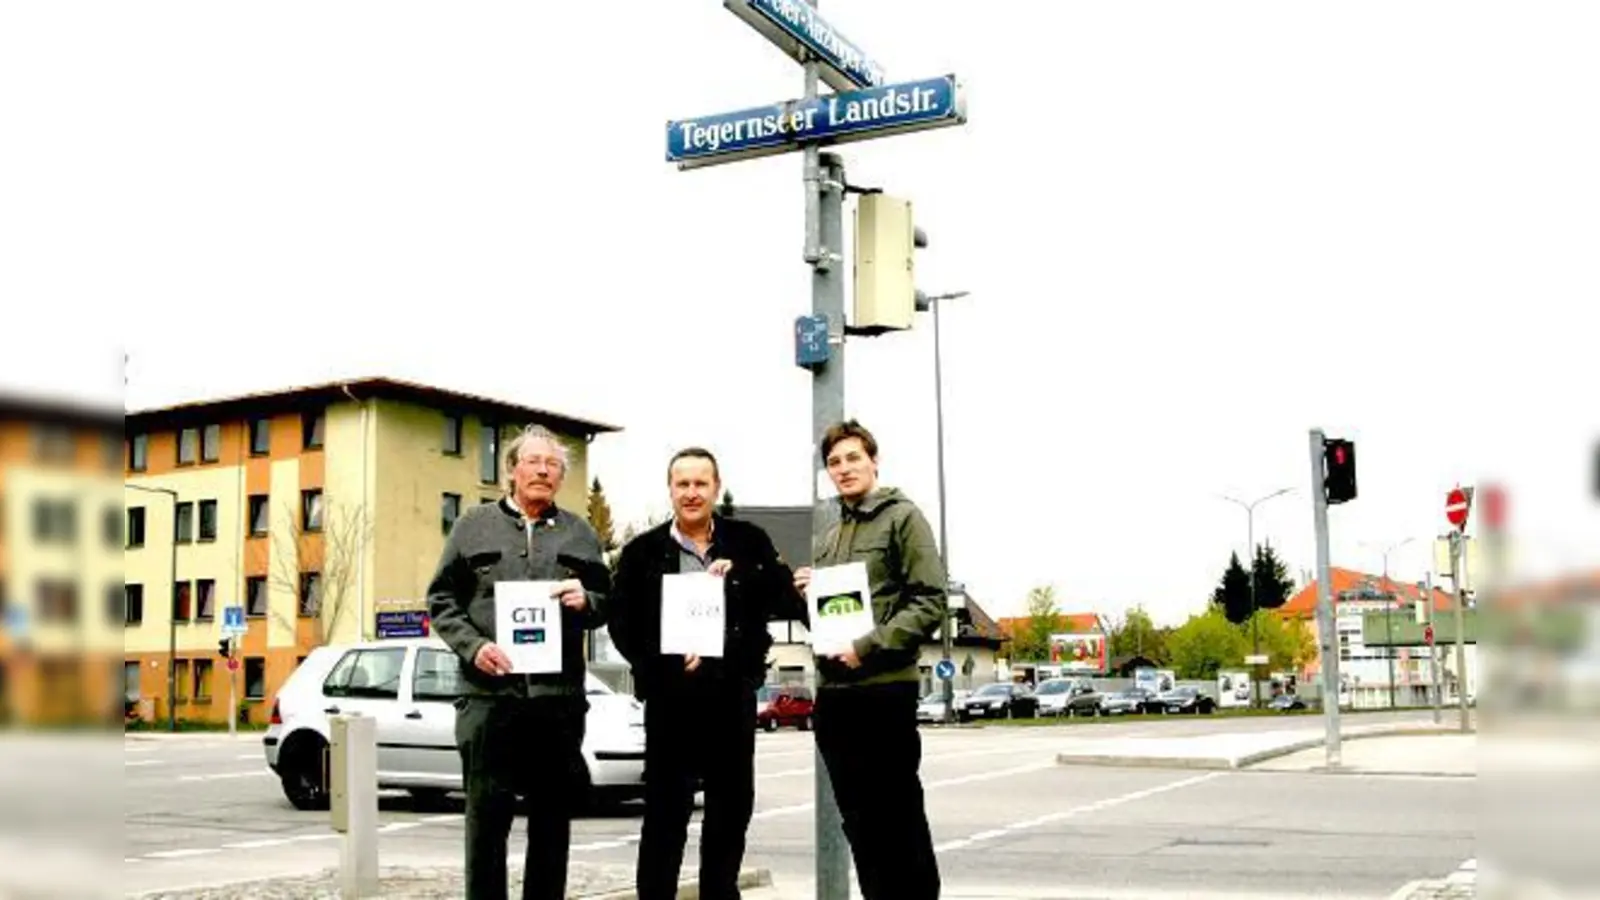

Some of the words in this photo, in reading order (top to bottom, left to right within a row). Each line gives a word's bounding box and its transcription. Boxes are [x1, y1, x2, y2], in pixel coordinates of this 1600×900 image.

[680, 107, 818, 150] Tegernseer
[828, 86, 939, 126] Landstr.
[512, 607, 546, 623] GTI
